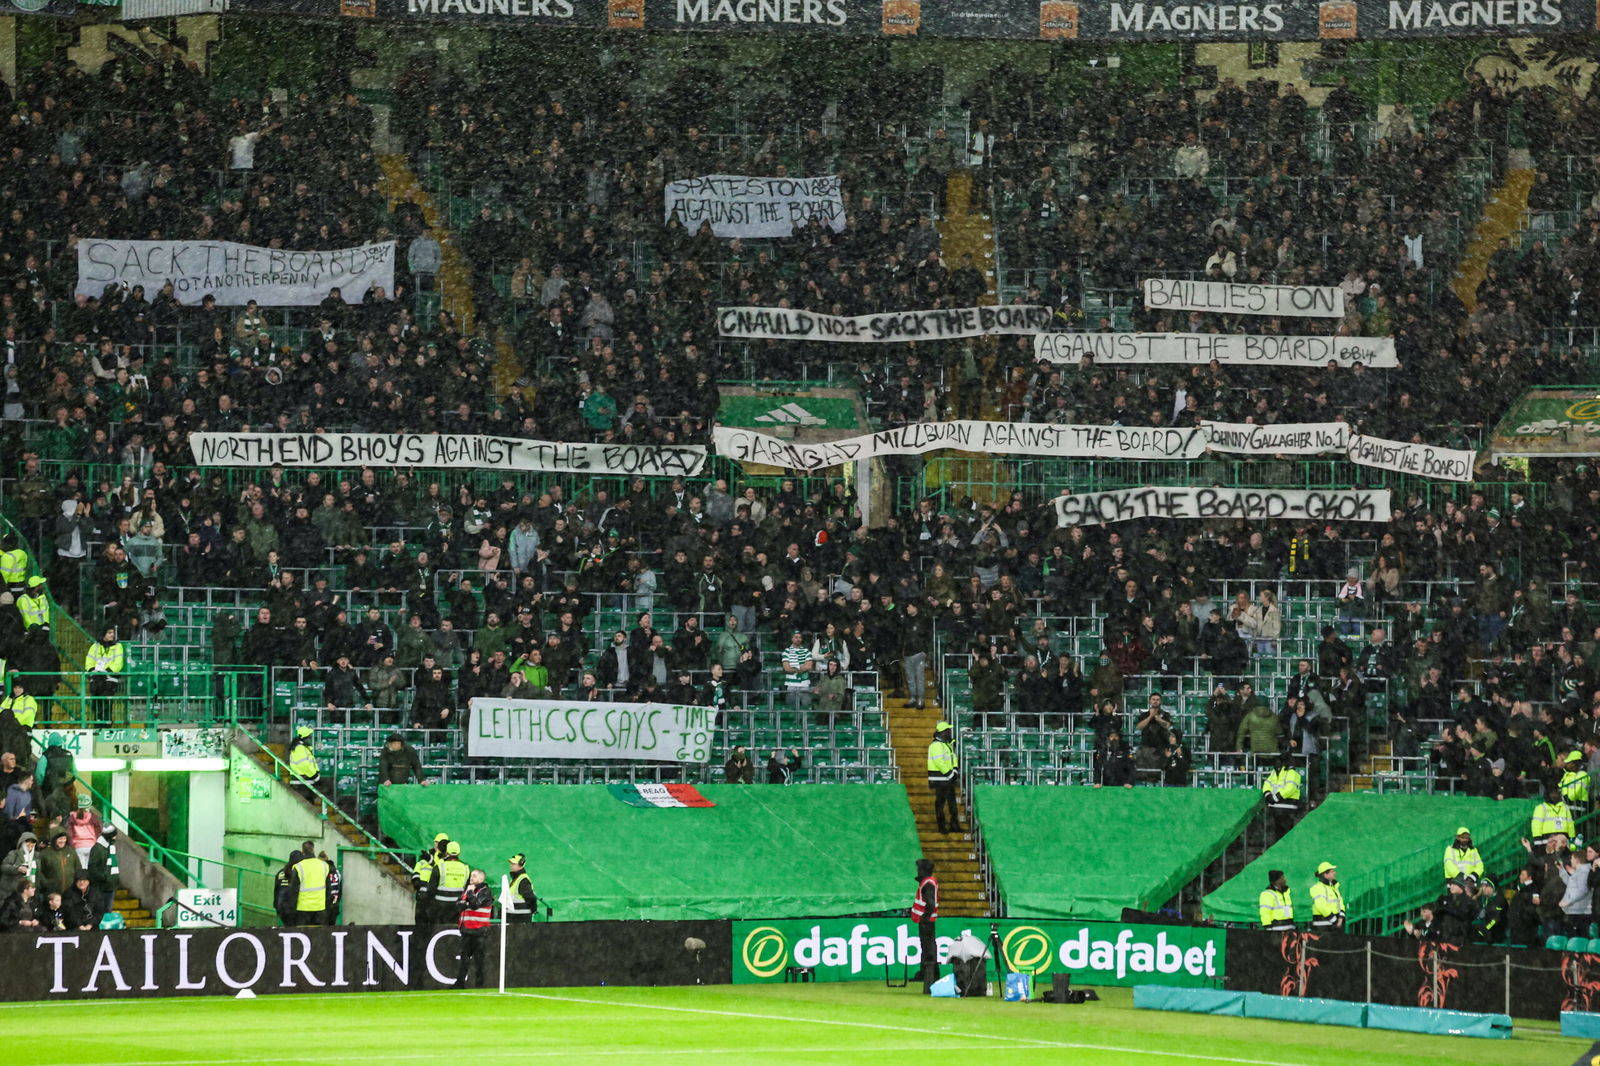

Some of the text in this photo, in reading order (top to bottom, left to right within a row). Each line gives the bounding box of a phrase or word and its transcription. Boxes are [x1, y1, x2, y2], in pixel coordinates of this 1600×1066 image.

[676, 0, 848, 26] MAGNERS
[1109, 3, 1285, 32] MAGNERS
[1388, 0, 1562, 29] MAGNERS
[673, 177, 810, 197] SPATESTON
[671, 198, 843, 225] AGAINST THE BOARD
[86, 242, 189, 282] SACK
[199, 244, 260, 275] THE
[269, 247, 368, 276] BOARD
[1150, 279, 1335, 312] BAILLIESTON
[925, 308, 977, 336] THE
[978, 307, 1053, 331] BOARD
[1040, 334, 1167, 362] AGAINST
[1174, 336, 1230, 361] THE
[872, 423, 973, 453] MILLBURN
[983, 422, 1066, 449] AGAINST
[1071, 427, 1113, 450] THE
[1117, 428, 1198, 458] BOARD!
[1250, 426, 1313, 450] GALLAGHER
[200, 434, 704, 475] NORTH END BHOYS AGAINST THE BOARD
[1350, 436, 1471, 480] AGAINST THE BOARD!
[1134, 489, 1189, 518] THE
[672, 706, 715, 733] TIME
[679, 732, 707, 746] TO
[676, 747, 706, 761] GO
[194, 894, 222, 906] Exit
[180, 909, 235, 921] Gate 14
[1058, 927, 1217, 980] dafabet
